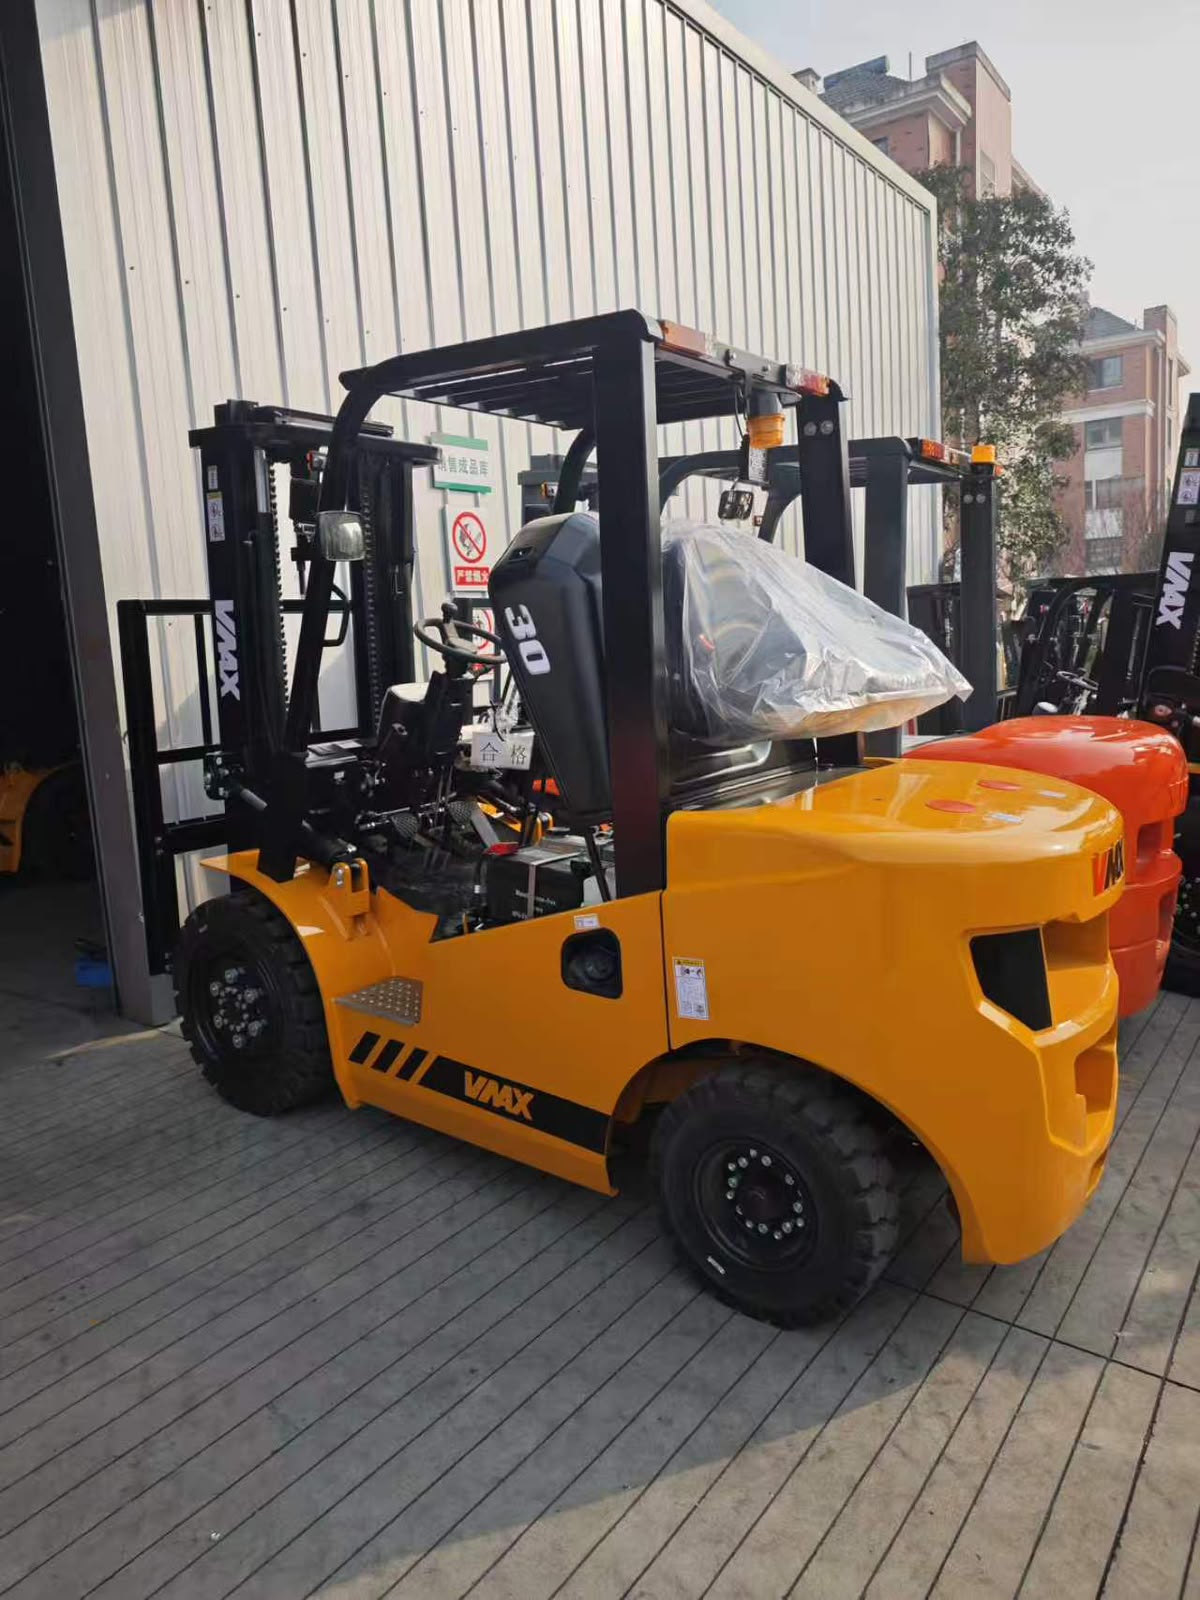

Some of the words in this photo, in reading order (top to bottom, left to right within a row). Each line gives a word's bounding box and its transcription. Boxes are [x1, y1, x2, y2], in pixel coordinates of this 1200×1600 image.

[1156, 552, 1195, 630] VMAX
[215, 600, 241, 701] VMAX
[504, 604, 551, 675] 30
[480, 742, 527, 765] 合格
[464, 1070, 535, 1121] VMAX
